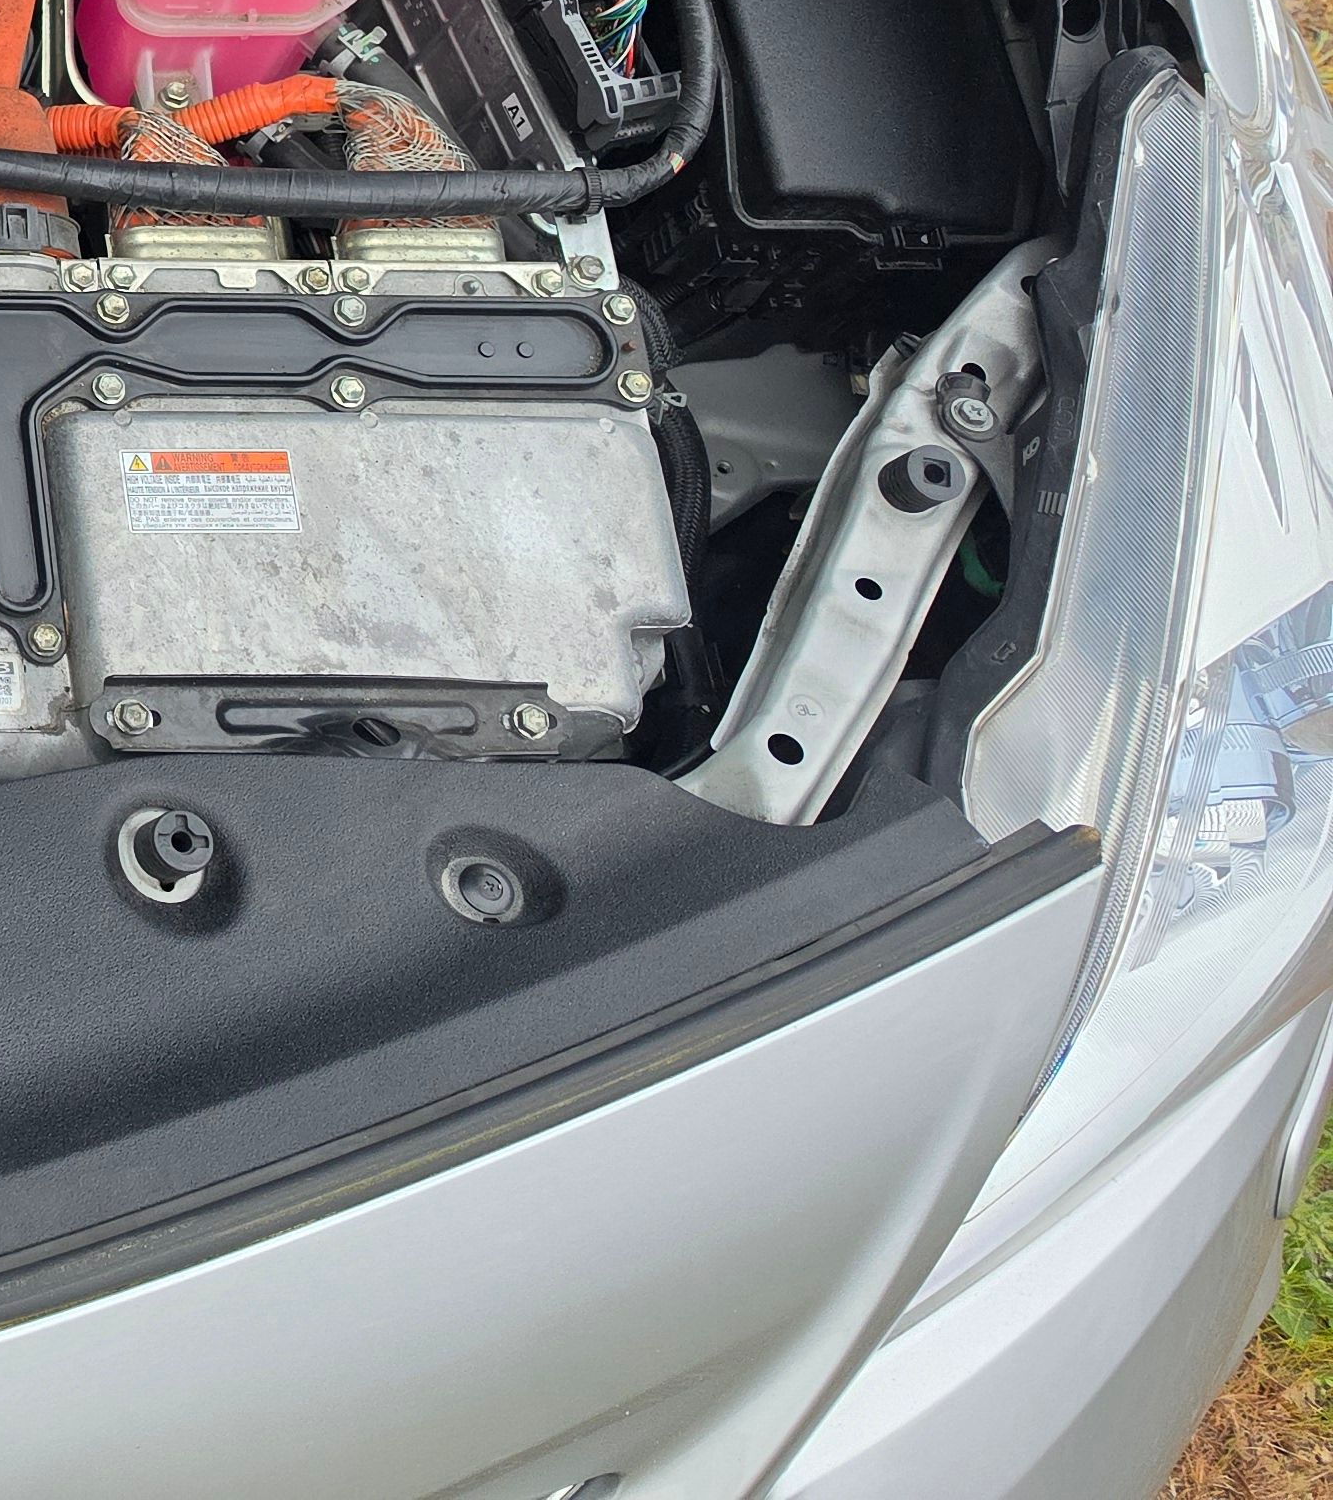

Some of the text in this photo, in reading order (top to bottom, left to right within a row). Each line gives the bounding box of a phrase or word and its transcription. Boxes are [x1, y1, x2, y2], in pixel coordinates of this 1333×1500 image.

[508, 105, 526, 128] A1
[172, 453, 214, 462] WARNING
[174, 463, 224, 471] AVERTISSEMENT
[141, 475, 163, 484] VOLTAGE
